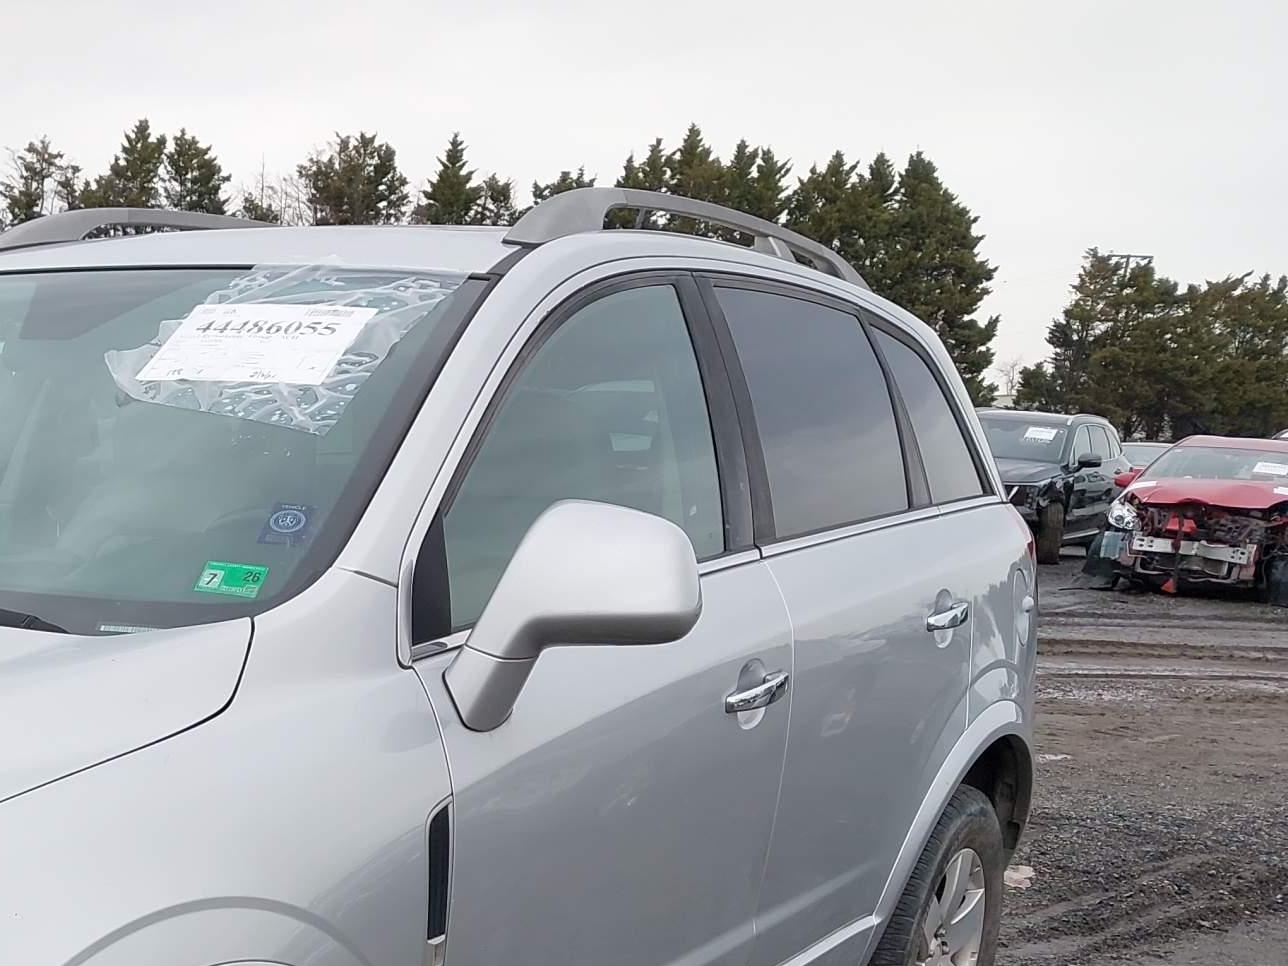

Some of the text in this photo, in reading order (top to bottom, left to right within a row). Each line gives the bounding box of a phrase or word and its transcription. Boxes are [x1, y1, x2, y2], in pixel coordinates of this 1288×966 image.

[196, 319, 341, 337] 44486055
[205, 571, 261, 586] 7 26
